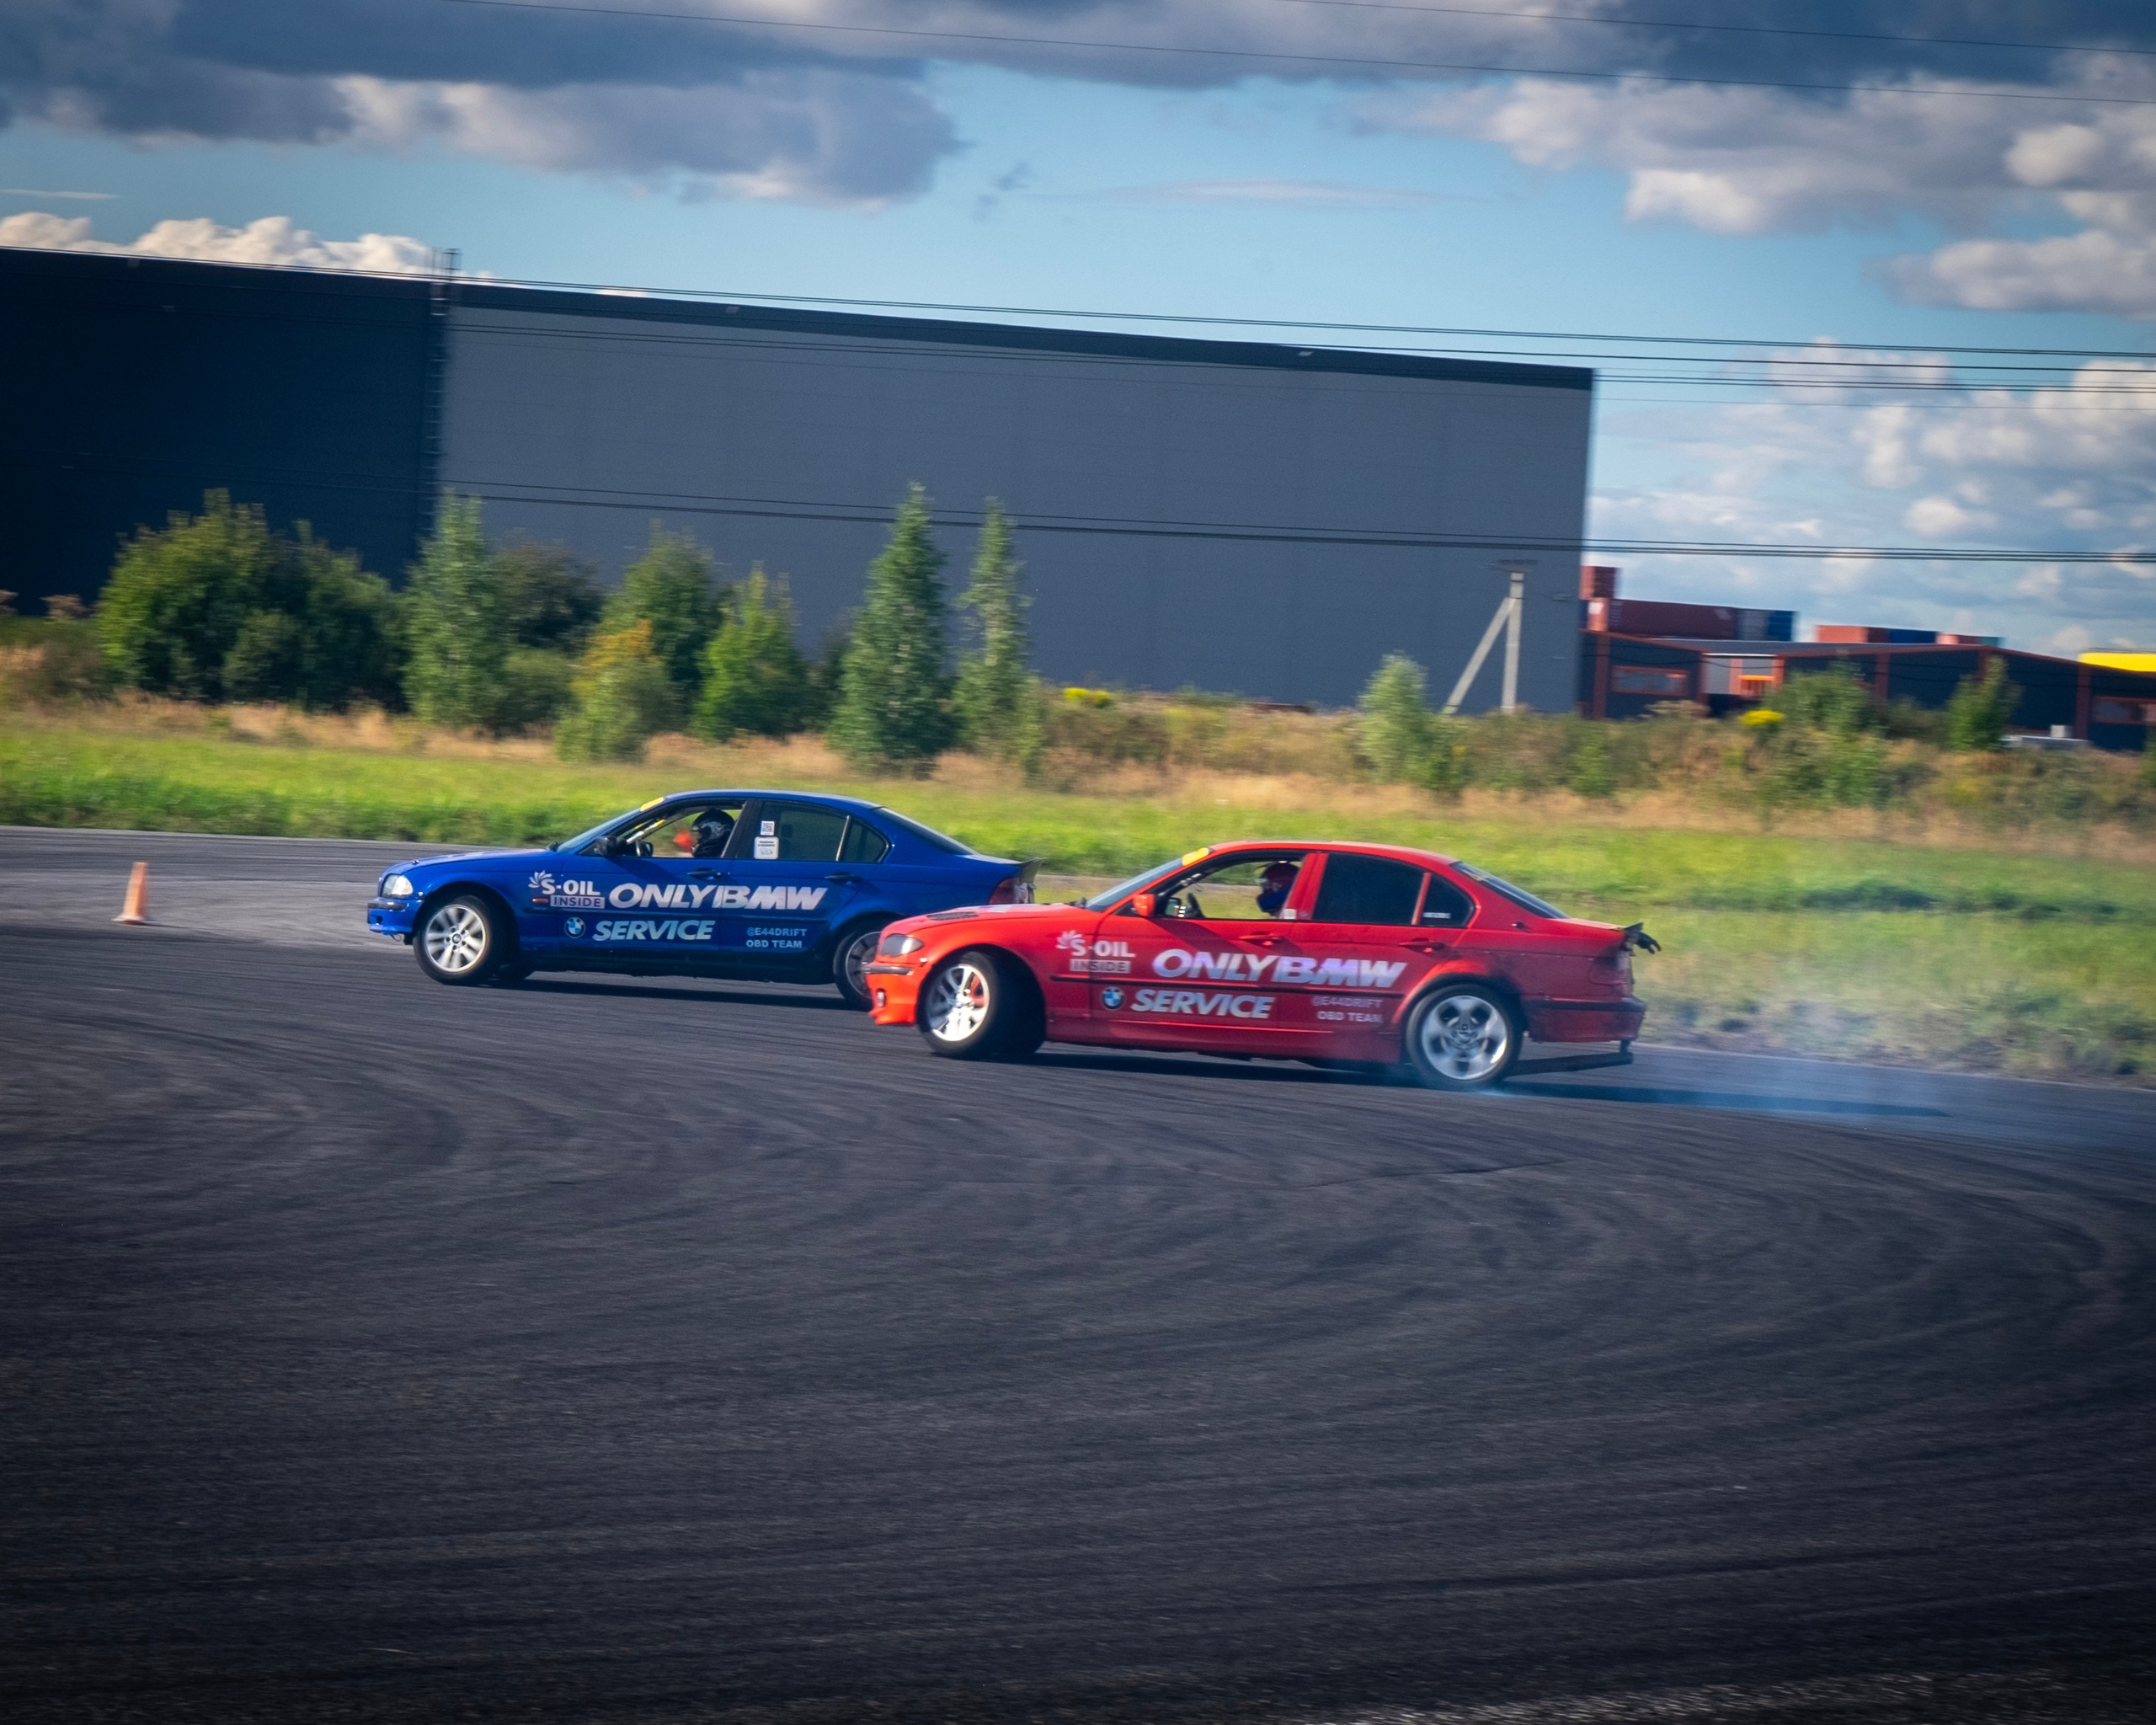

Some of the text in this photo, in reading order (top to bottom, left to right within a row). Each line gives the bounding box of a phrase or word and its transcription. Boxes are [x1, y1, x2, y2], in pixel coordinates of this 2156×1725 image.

[542, 878, 601, 895] S-OIL
[552, 896, 603, 908] INSIDE
[592, 920, 716, 941] SERVICE
[745, 939, 803, 948] OBD TEAM
[1070, 936, 1136, 958] S-OIL
[1070, 959, 1130, 973] INSIDE
[1130, 988, 1275, 1019] SERVICE
[1317, 1011, 1345, 1021] OBD
